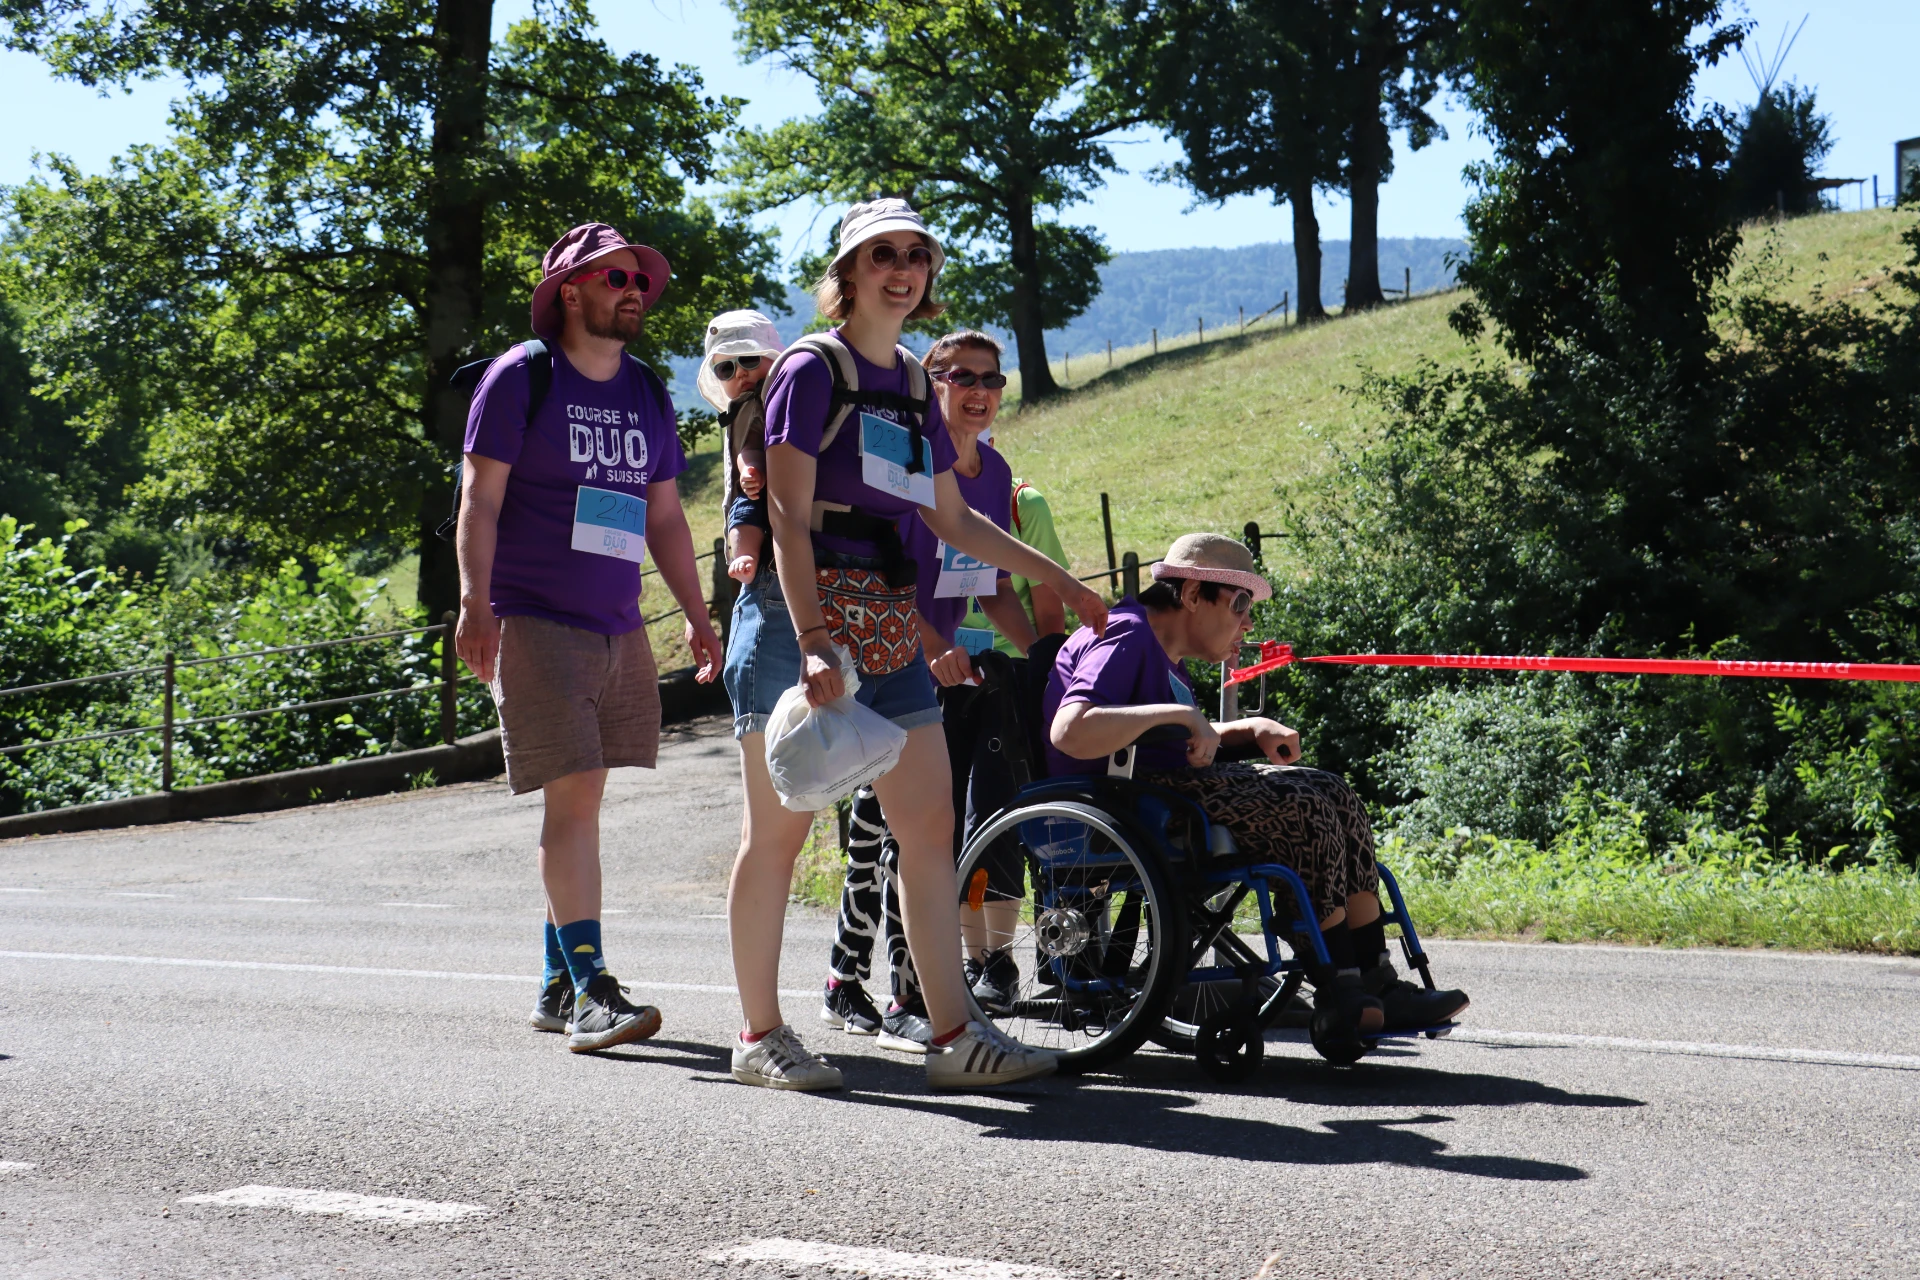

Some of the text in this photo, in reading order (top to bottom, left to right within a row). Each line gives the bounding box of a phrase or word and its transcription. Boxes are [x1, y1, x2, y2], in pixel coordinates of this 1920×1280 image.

[566, 404, 622, 424] COURSE
[569, 423, 648, 469] DUO
[606, 469, 648, 485] SUISSE
[887, 469, 910, 489] DUO
[596, 495, 640, 528] 214
[603, 534, 627, 550] DUO
